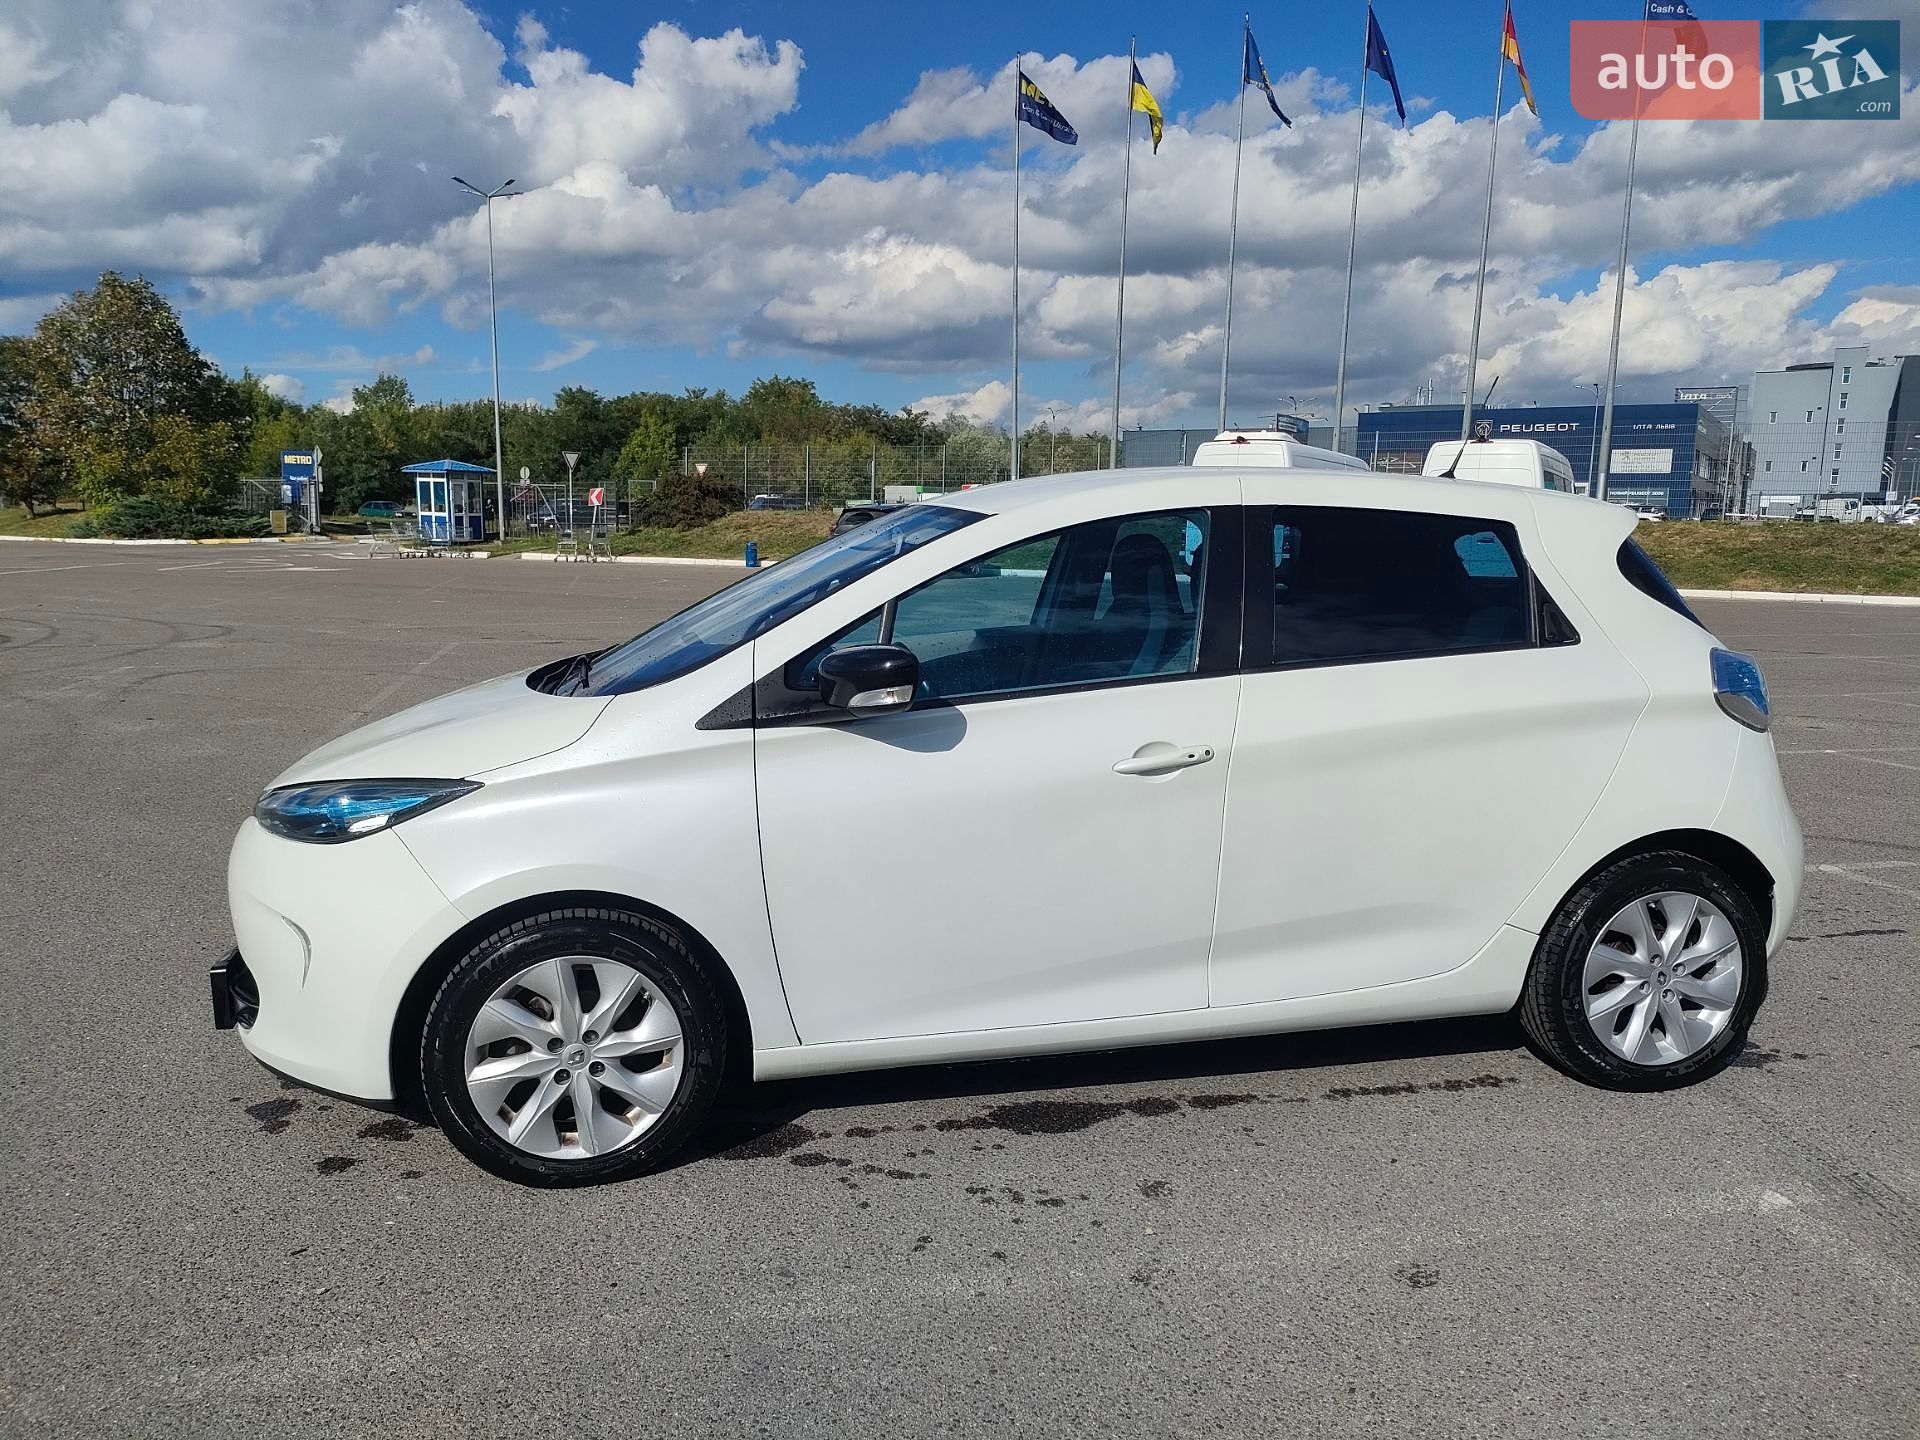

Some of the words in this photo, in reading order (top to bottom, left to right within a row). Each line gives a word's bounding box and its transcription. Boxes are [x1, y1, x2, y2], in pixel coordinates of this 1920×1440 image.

[1650, 3, 1675, 13] Cash
[1676, 5, 1684, 14] &
[1500, 423, 1580, 432] PEUGEOT
[284, 455, 312, 464] METRO
